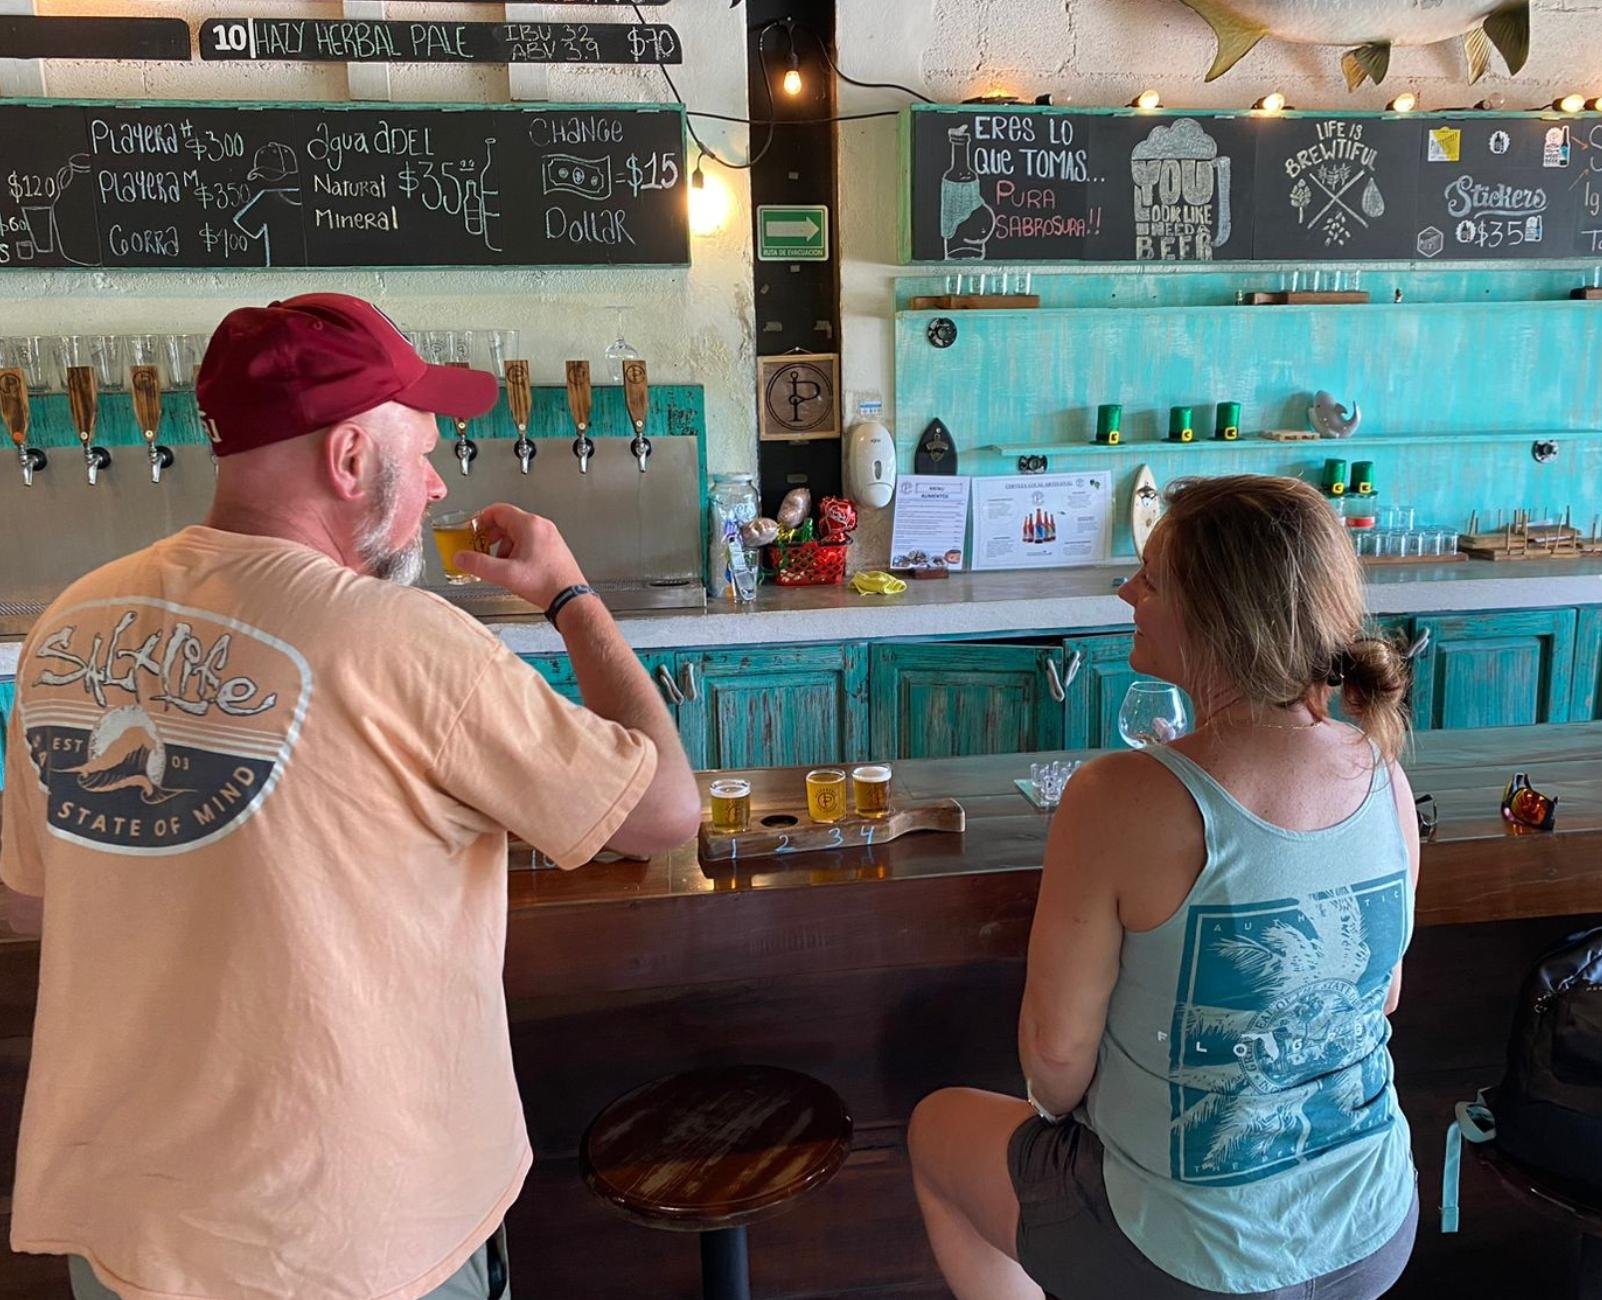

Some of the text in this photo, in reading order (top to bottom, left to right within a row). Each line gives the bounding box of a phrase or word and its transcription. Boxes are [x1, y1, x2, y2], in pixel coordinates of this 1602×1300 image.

[212, 22, 474, 57] 10 HAZY HERBAL PALE
[504, 24, 594, 42] IBU 32
[627, 26, 675, 62] $70
[511, 41, 601, 61] ABV 3.9
[185, 130, 244, 161] $300
[1050, 118, 1073, 146] LO
[1316, 120, 1363, 140] LIFE IS
[1019, 148, 1105, 182] TOMAS...
[1285, 138, 1378, 178] BREWTIFUL
[8, 170, 55, 203] $120
[184, 169, 199, 187] M
[193, 182, 250, 209] $350
[626, 152, 678, 198] $15
[1131, 159, 1214, 205] YOU
[1134, 184, 1213, 225] LOOK LIKE
[1444, 175, 1547, 218] Stickers
[995, 206, 1102, 240] SABROSURA!!
[1151, 222, 1195, 236] NEED
[1473, 219, 1524, 248] $35
[1136, 233, 1213, 260] BEER
[53, 737, 83, 752] EST
[171, 755, 190, 771] 03
[57, 766, 255, 837] STATE OF MIND
[731, 826, 875, 859] 1 2 3 4
